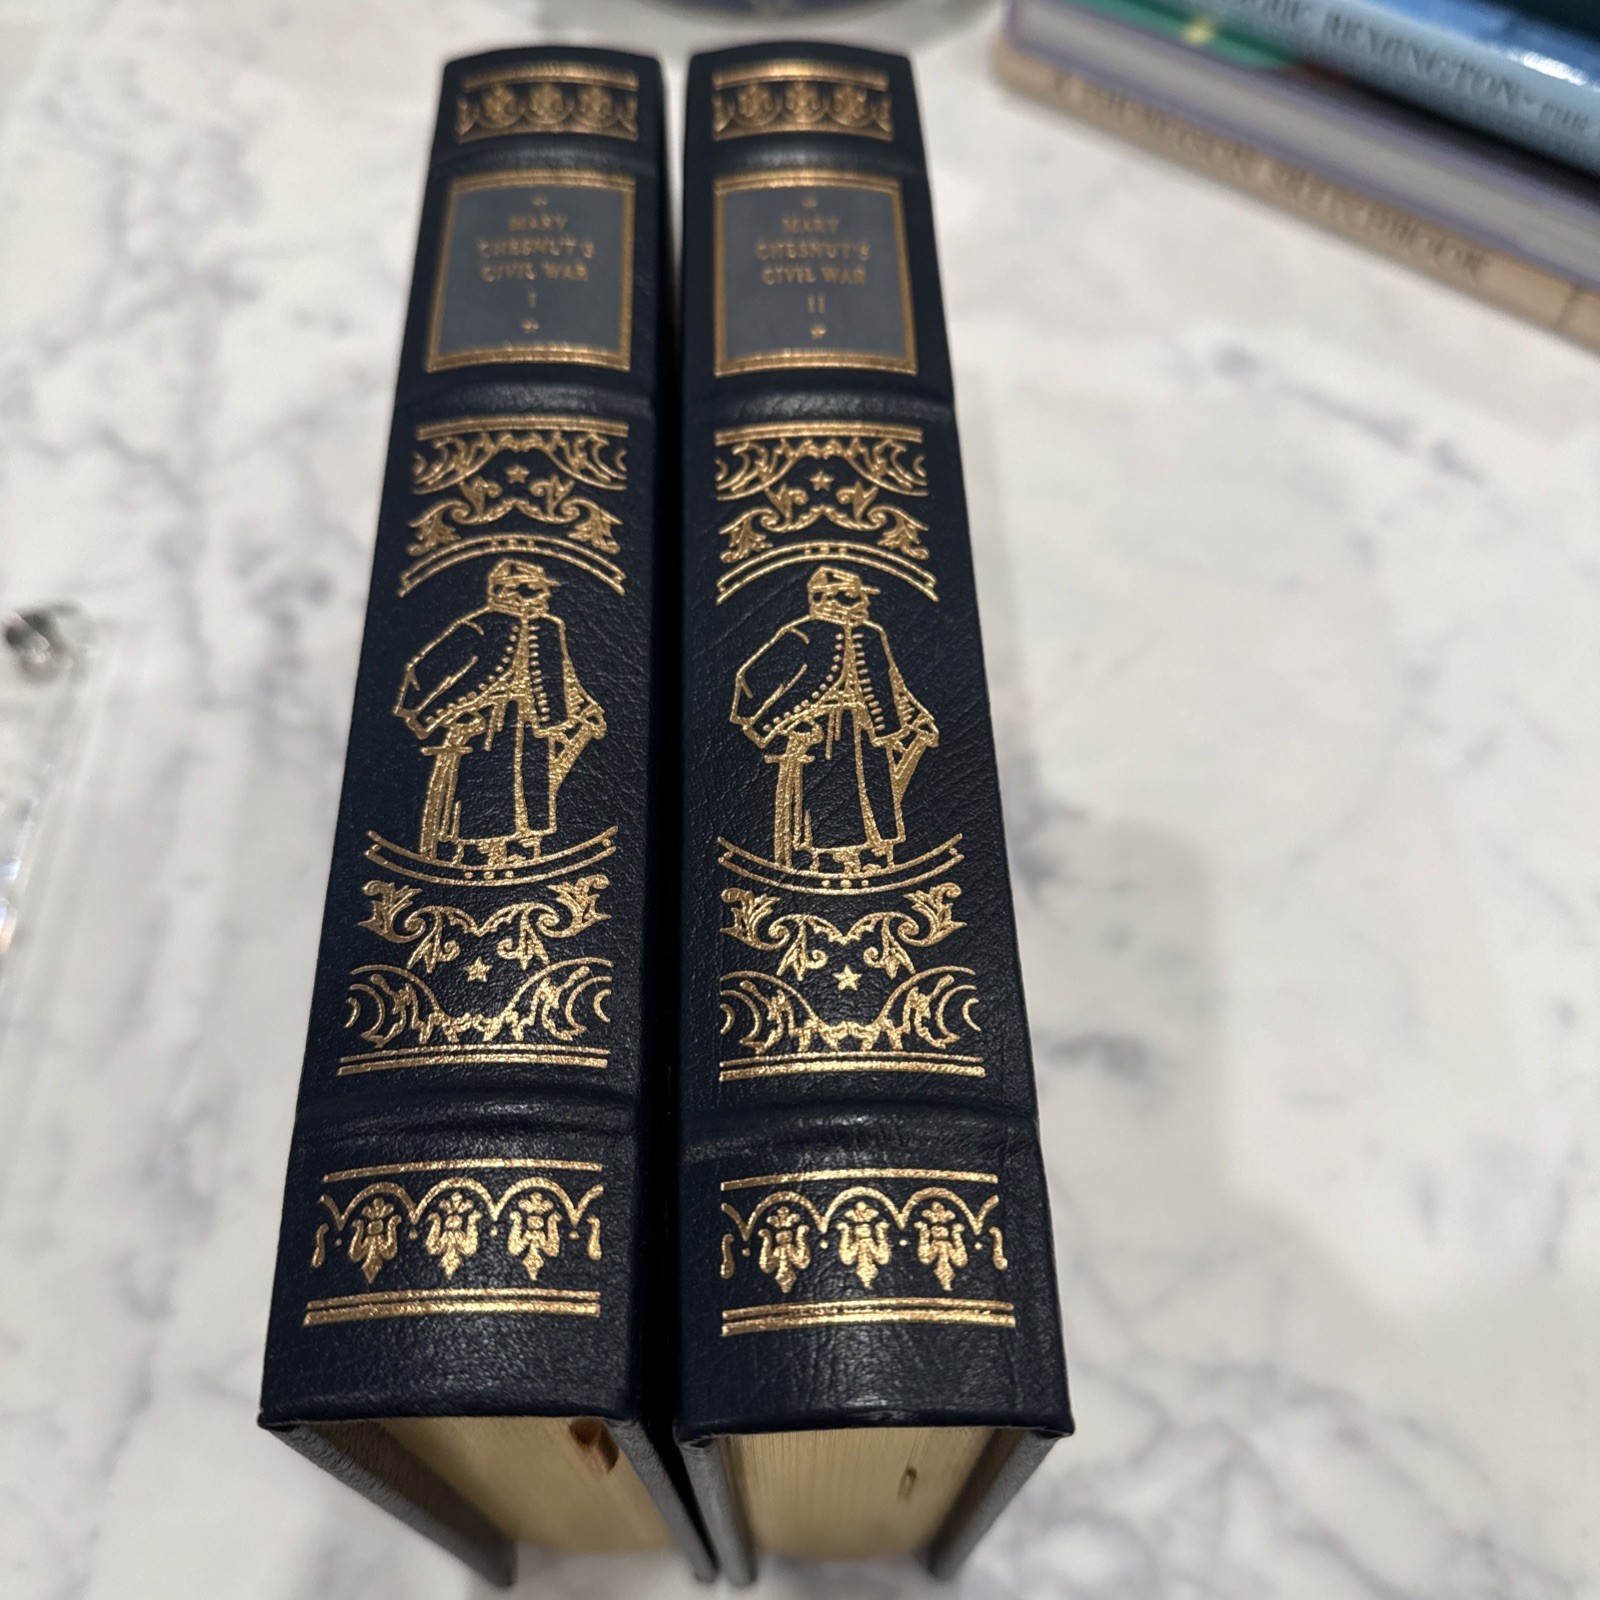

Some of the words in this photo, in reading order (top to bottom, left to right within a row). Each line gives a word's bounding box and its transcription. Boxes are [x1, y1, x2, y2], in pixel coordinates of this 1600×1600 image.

[481, 261, 535, 282] CIVIL
[541, 261, 589, 281] WAR
[761, 264, 816, 286] CIVIL
[821, 265, 867, 285] WAR
[807, 294, 826, 314] II
